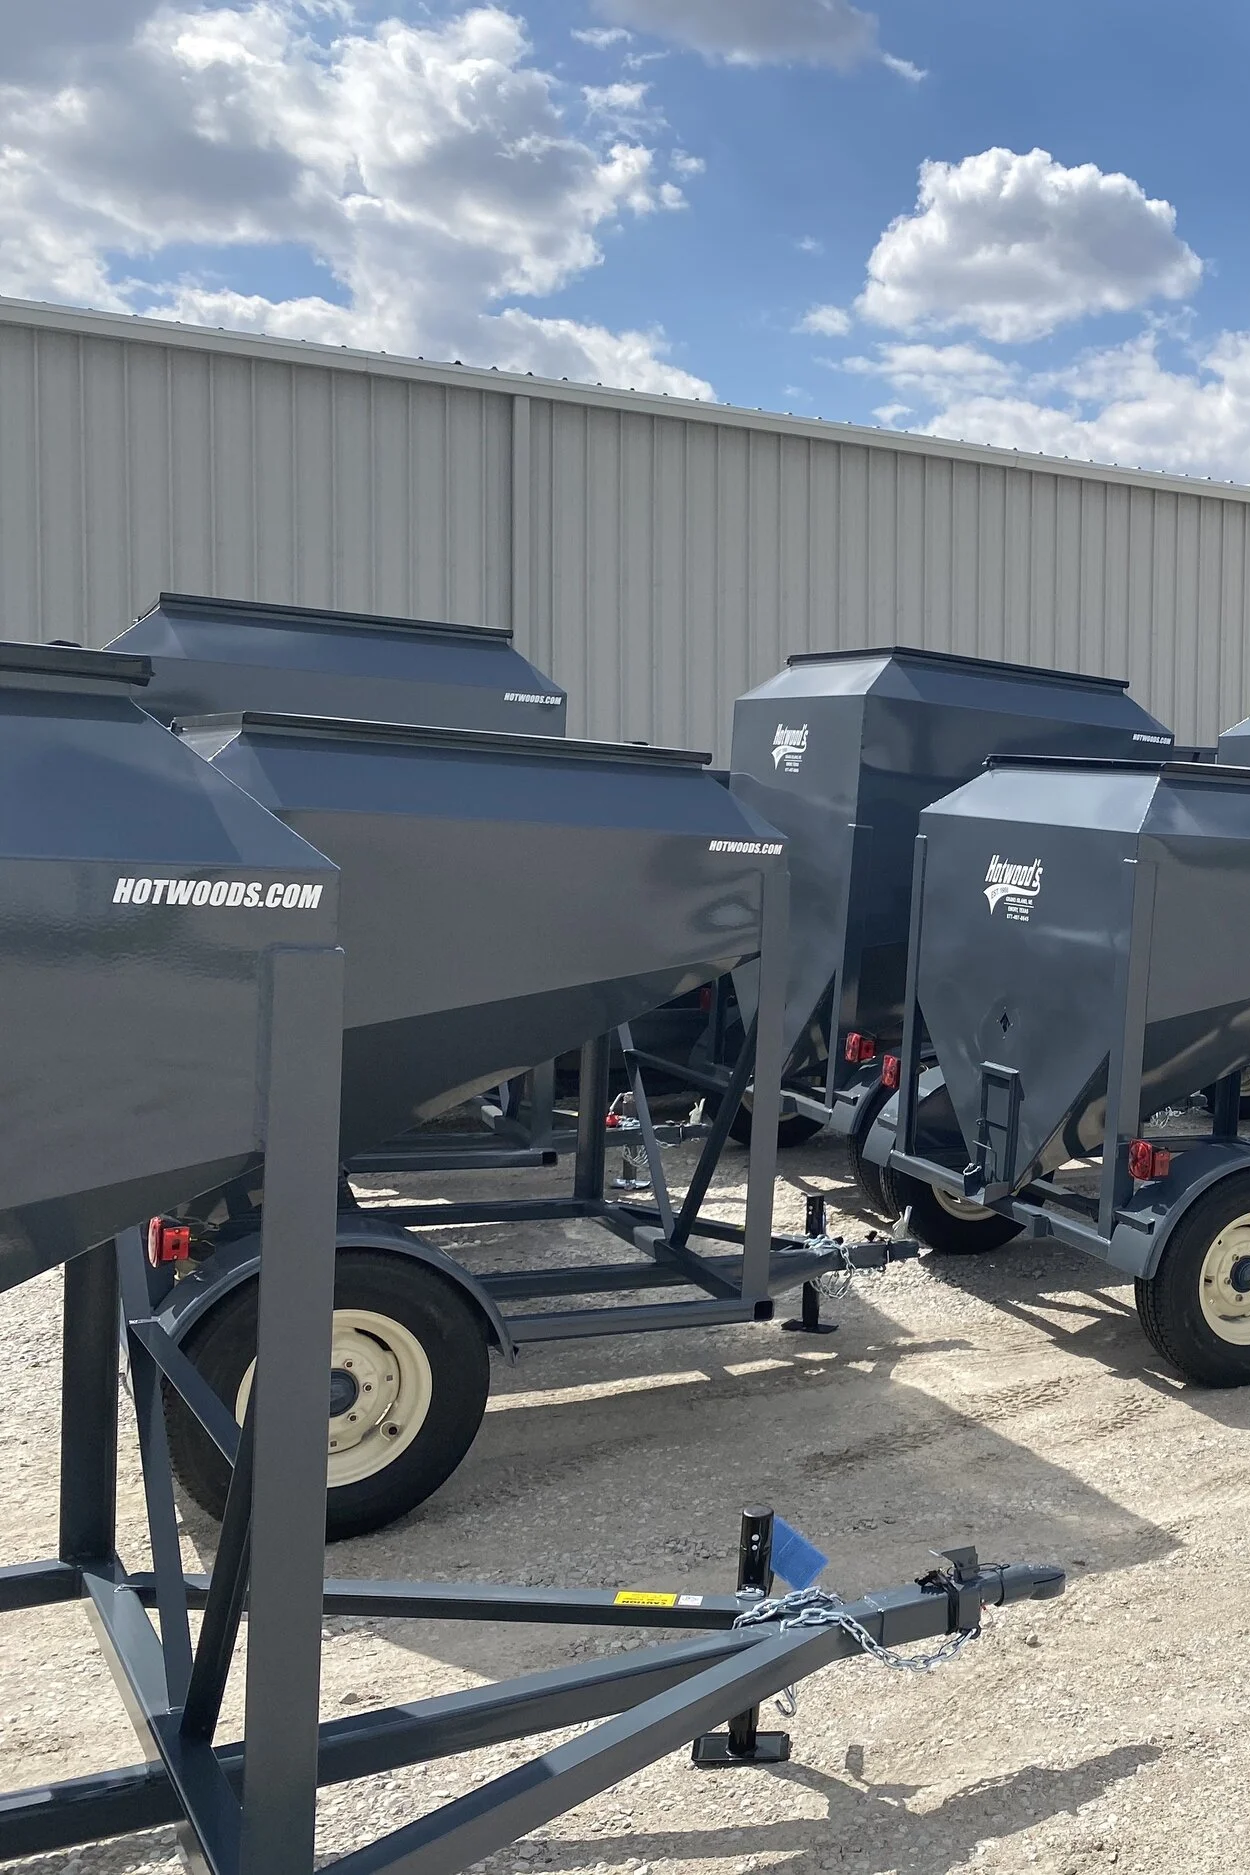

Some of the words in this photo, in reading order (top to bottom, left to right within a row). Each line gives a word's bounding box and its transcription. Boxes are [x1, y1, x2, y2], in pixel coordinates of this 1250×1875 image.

[504, 692, 562, 705] HOTWOODS.COM
[708, 840, 783, 855] HOTWOODS.COM
[984, 854, 1043, 888] Hotwood's
[112, 877, 323, 909] HOTWOODS.COM
